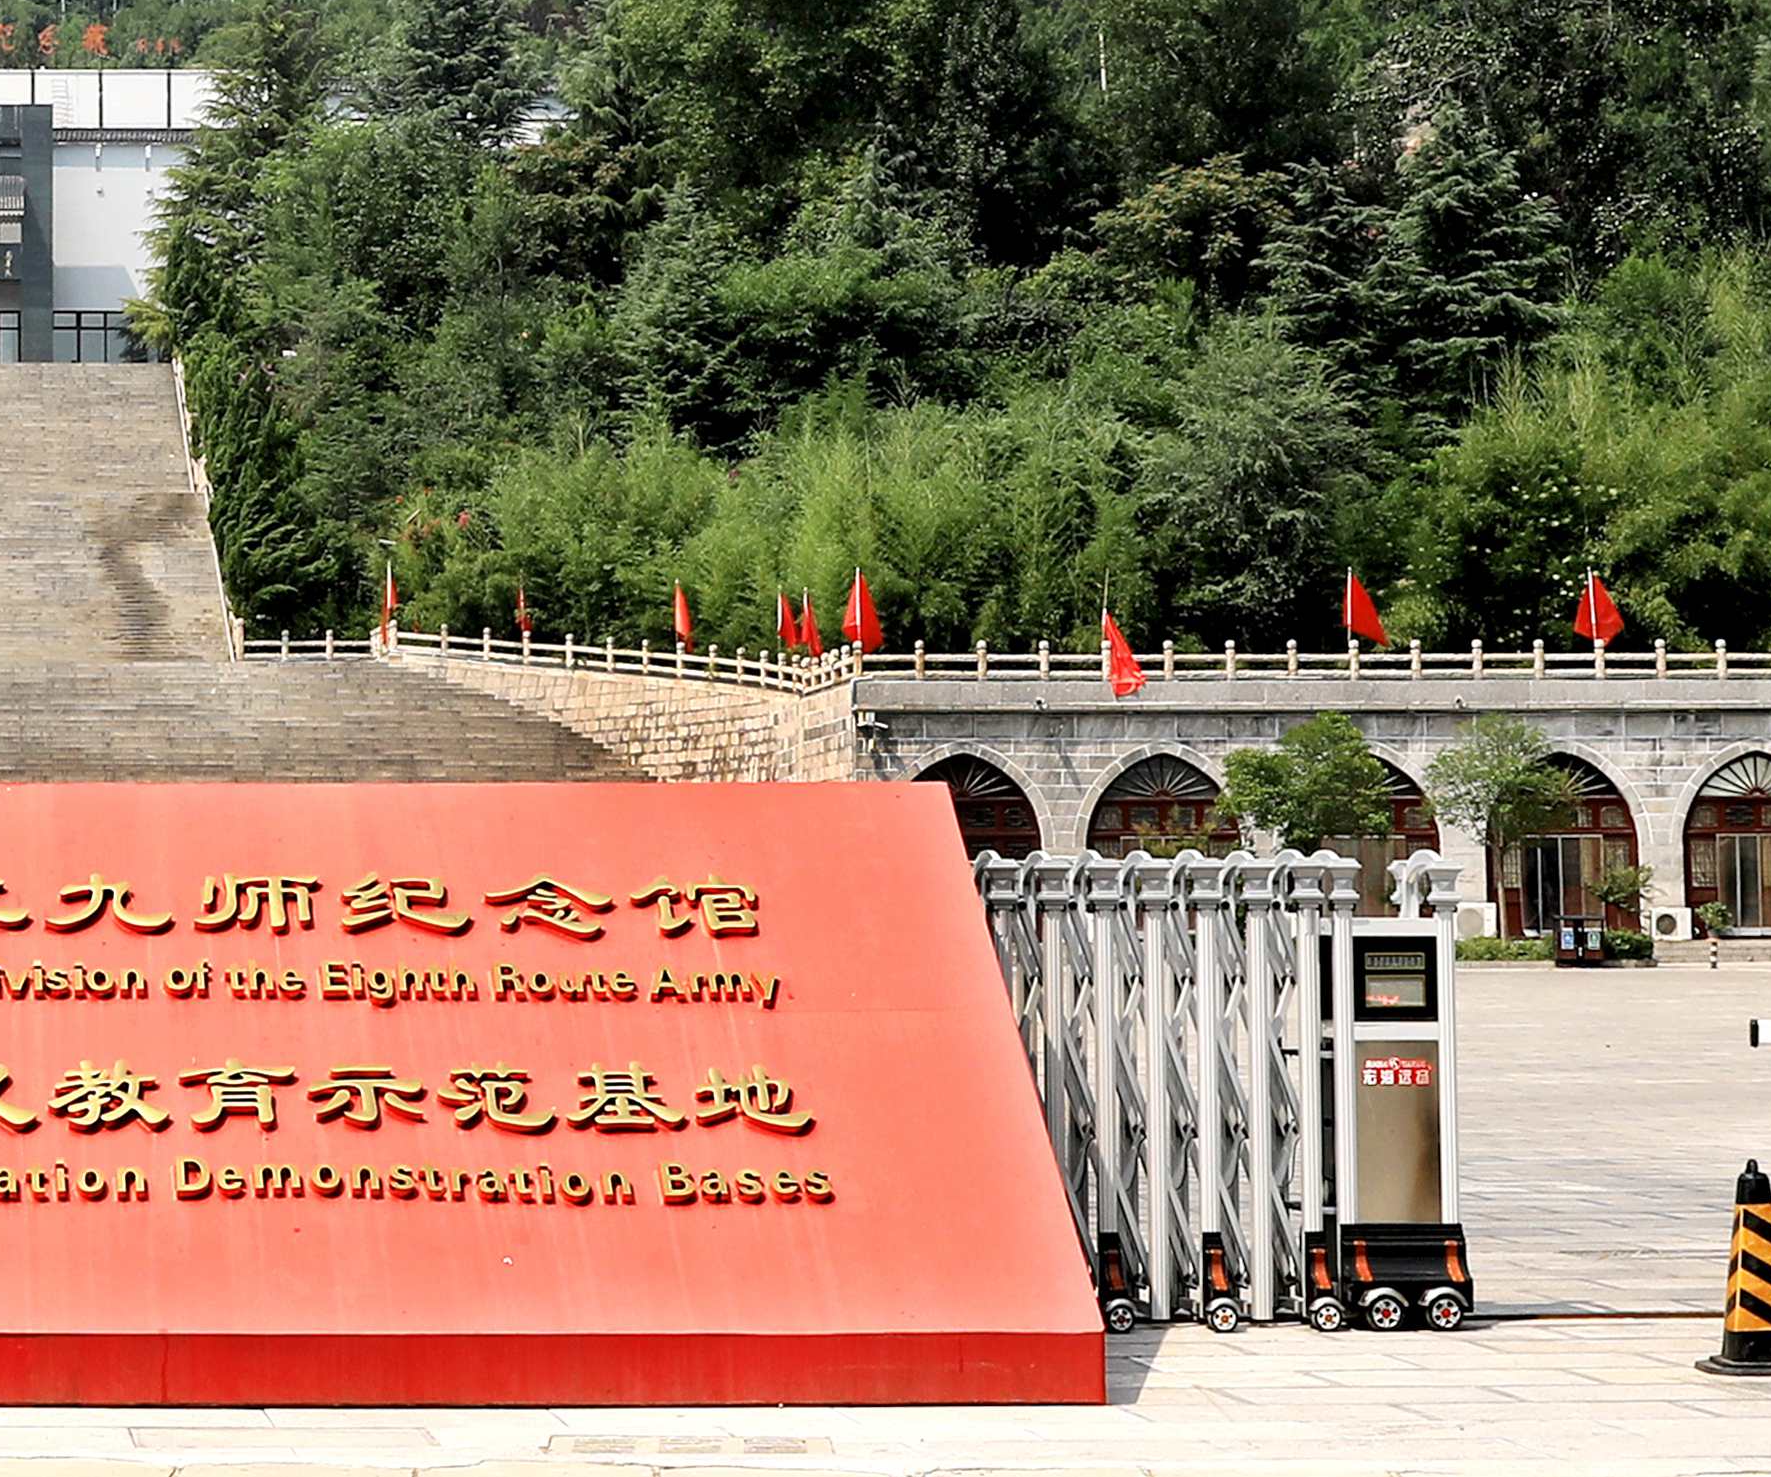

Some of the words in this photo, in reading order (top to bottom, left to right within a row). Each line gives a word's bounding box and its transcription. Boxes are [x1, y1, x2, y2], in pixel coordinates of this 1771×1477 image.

[163, 959, 213, 1000] of
[224, 959, 306, 1000] the
[319, 959, 481, 1009] Eighth
[491, 962, 639, 1003] Route
[649, 962, 782, 1010] Army
[173, 1156, 637, 1205] Demonstration
[656, 1161, 837, 1205] Bases
